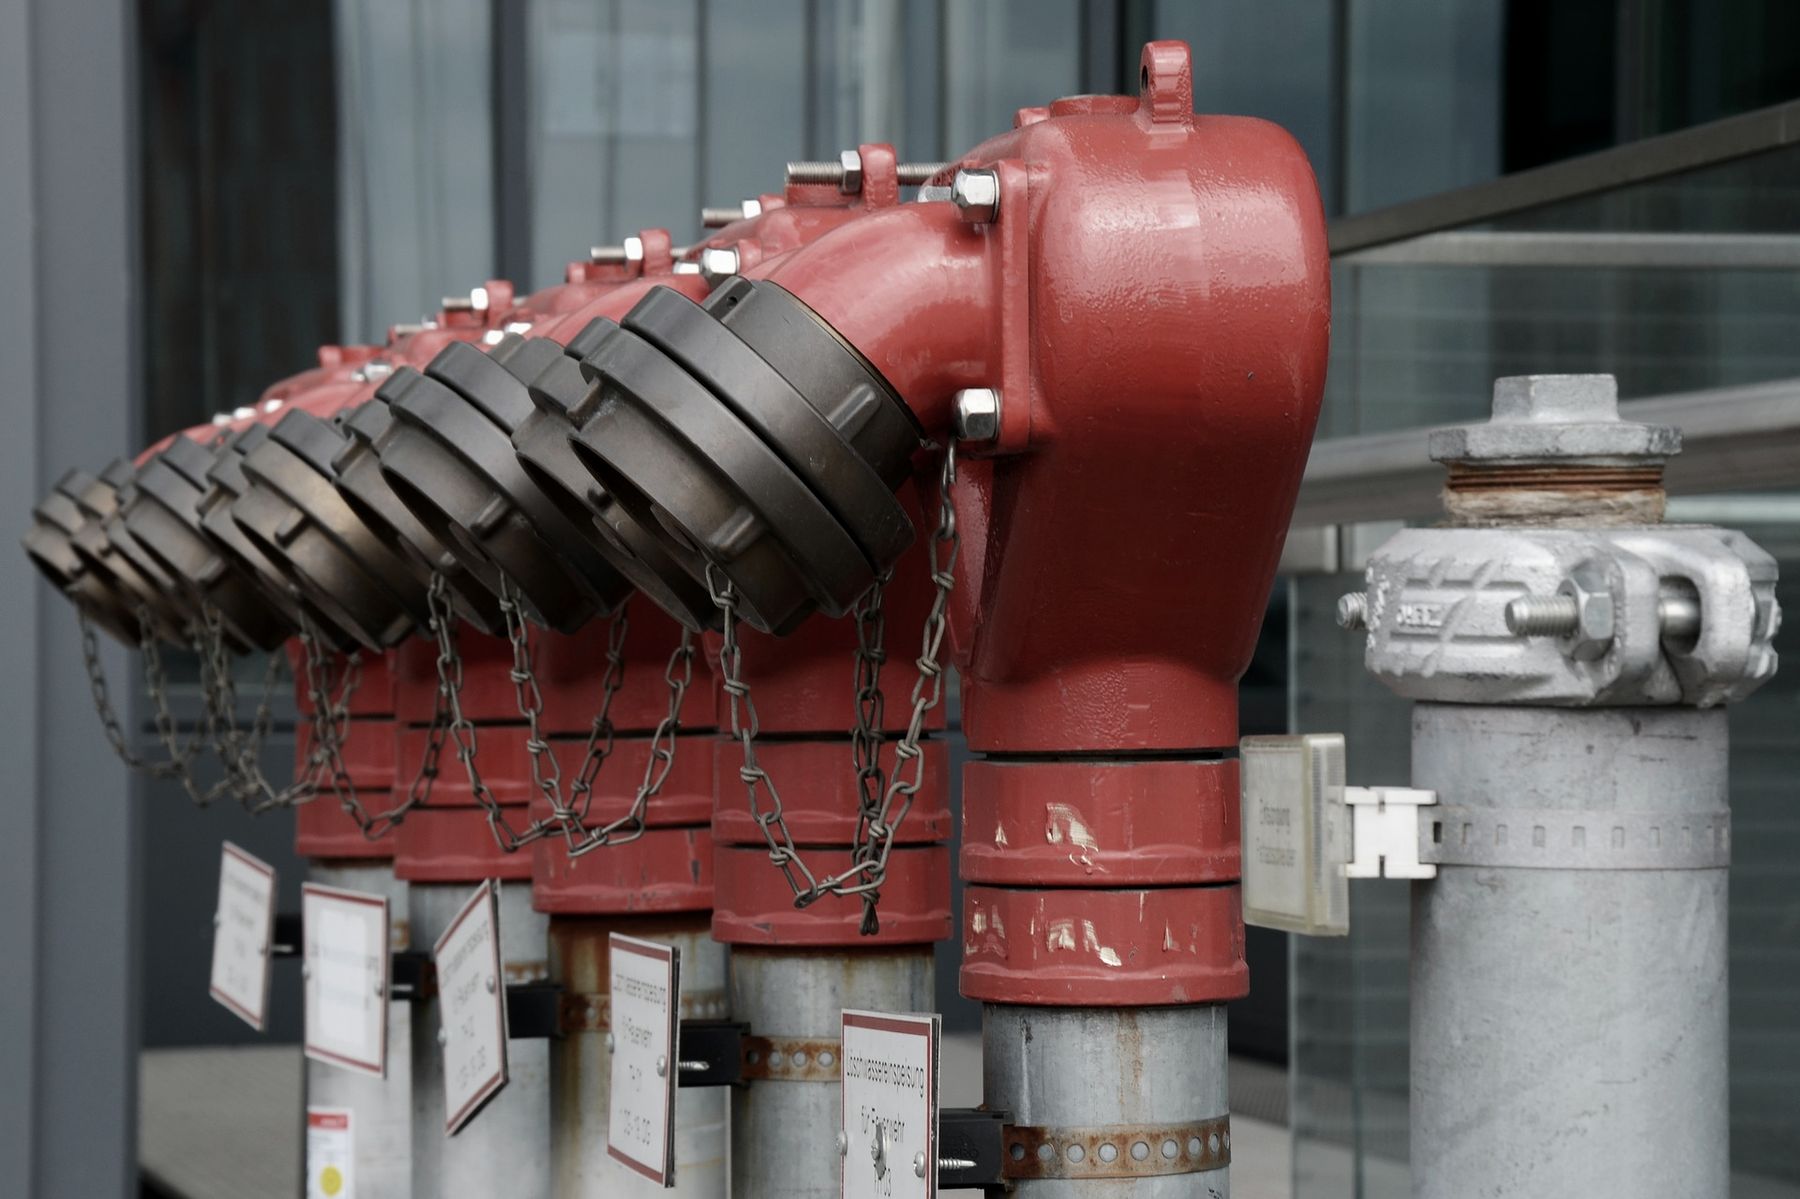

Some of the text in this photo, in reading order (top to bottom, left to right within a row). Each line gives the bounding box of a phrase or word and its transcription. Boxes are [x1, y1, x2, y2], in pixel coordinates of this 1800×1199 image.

[846, 1047, 924, 1098] Löschwassereinspeisung
[861, 1105, 905, 1143] für Ferwehr
